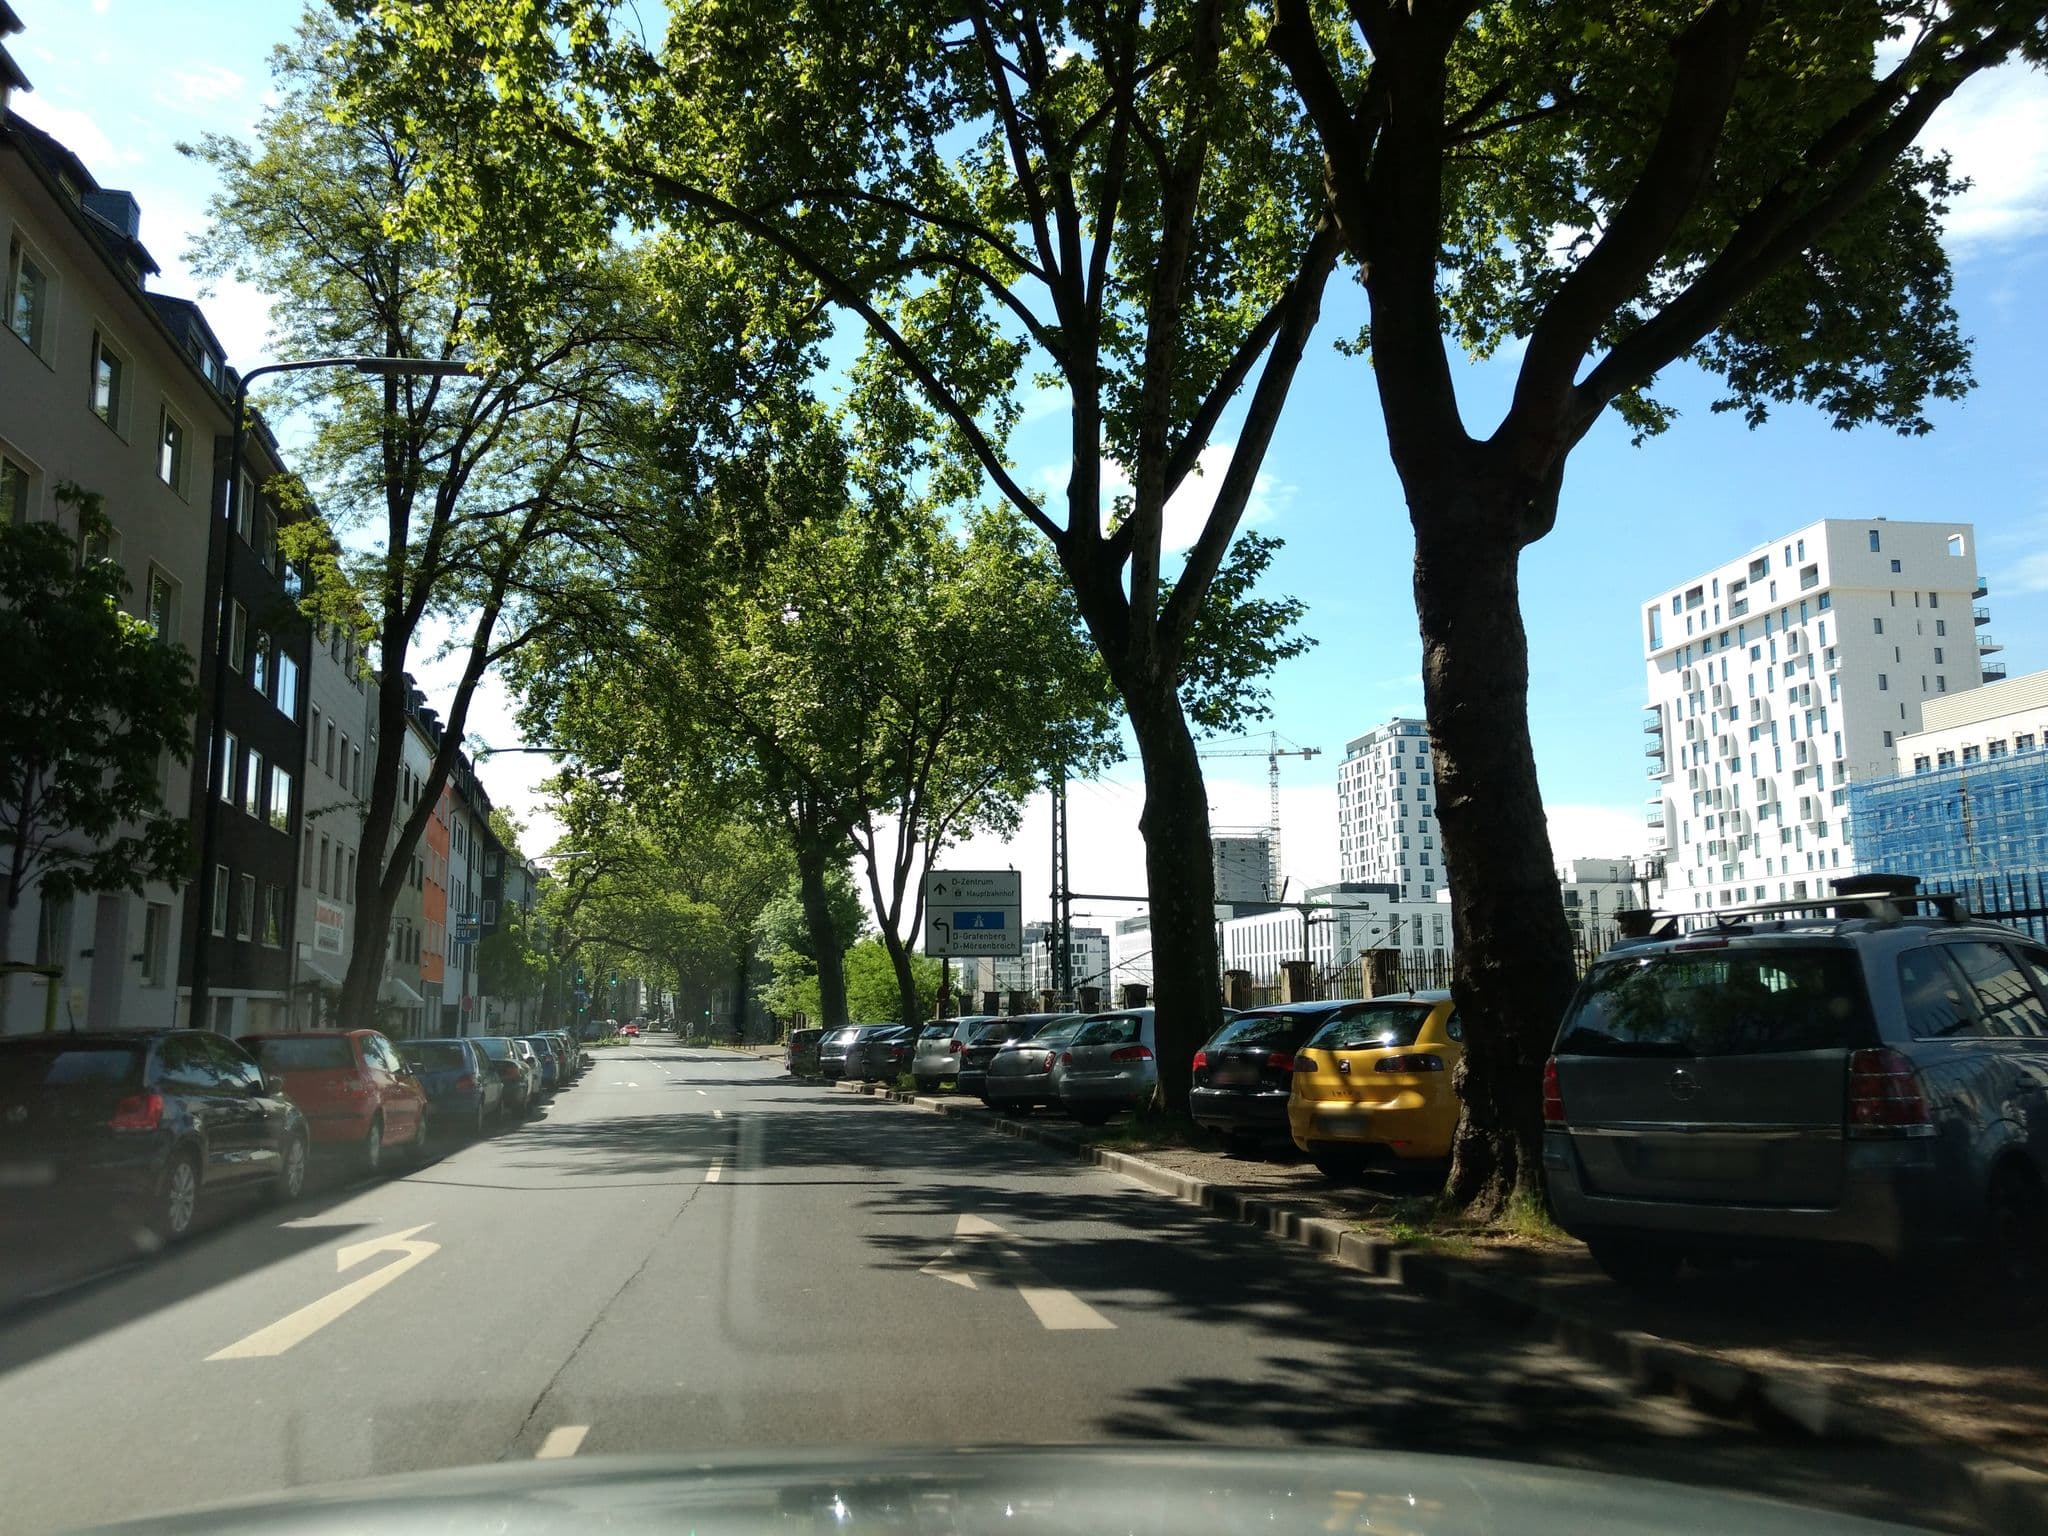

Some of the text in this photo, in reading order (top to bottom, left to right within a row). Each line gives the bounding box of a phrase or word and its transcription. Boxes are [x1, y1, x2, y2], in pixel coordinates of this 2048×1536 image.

[952, 878, 994, 886] D-Zentrum
[966, 890, 1015, 898] Hauptbahnhof
[953, 932, 1006, 941] D-Grafenberg
